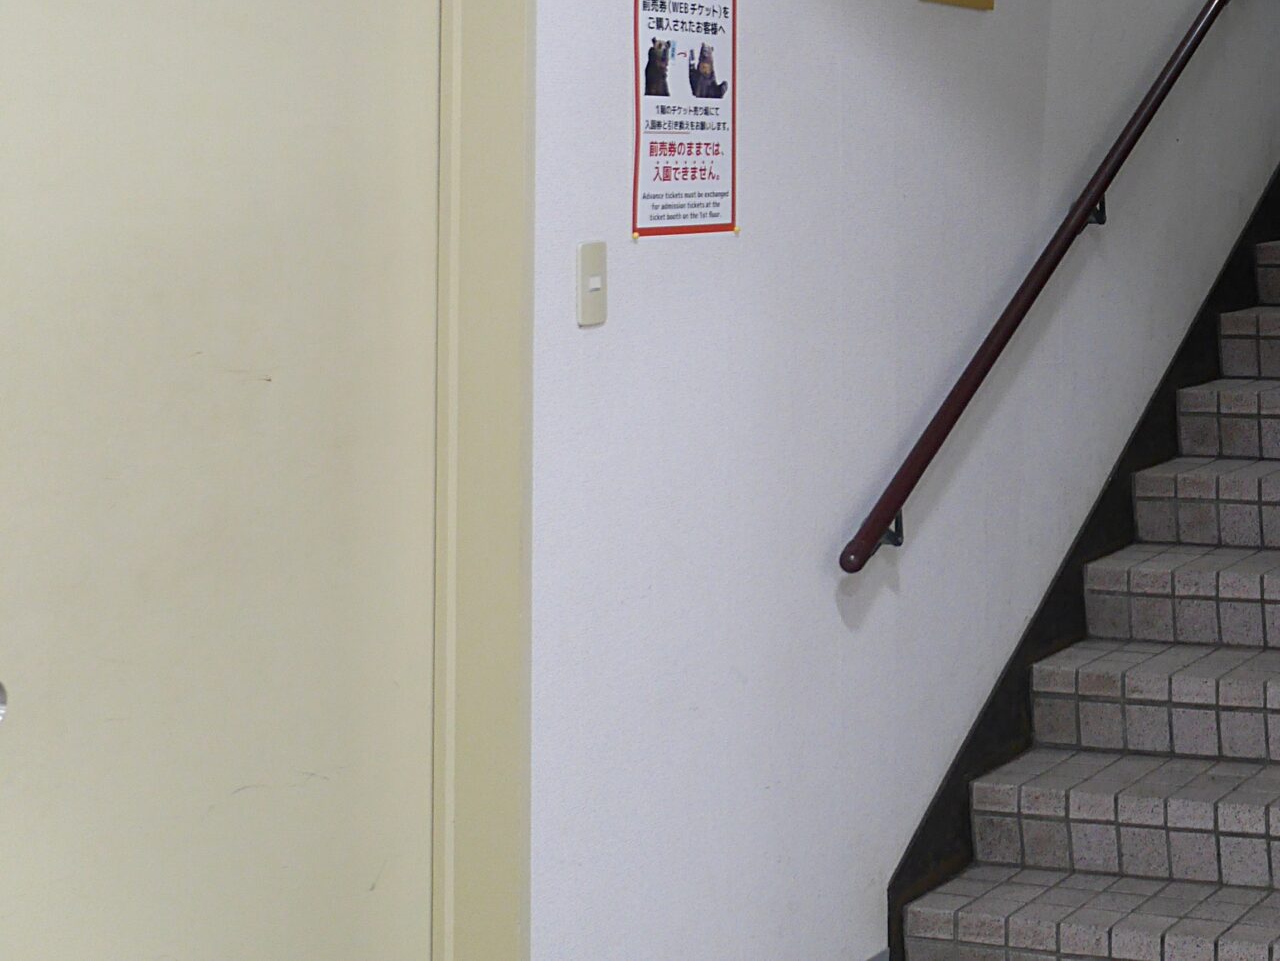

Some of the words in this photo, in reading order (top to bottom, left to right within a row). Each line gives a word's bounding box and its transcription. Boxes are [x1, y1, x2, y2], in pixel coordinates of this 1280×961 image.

[647, 16, 726, 35] ご購入されたお客様へ
[649, 140, 725, 157] 前売券のままでは、
[652, 165, 721, 182] 入園できません。
[665, 191, 683, 199] tickets
[651, 202, 660, 210] for
[687, 201, 705, 209] tickets
[690, 211, 698, 219] the
